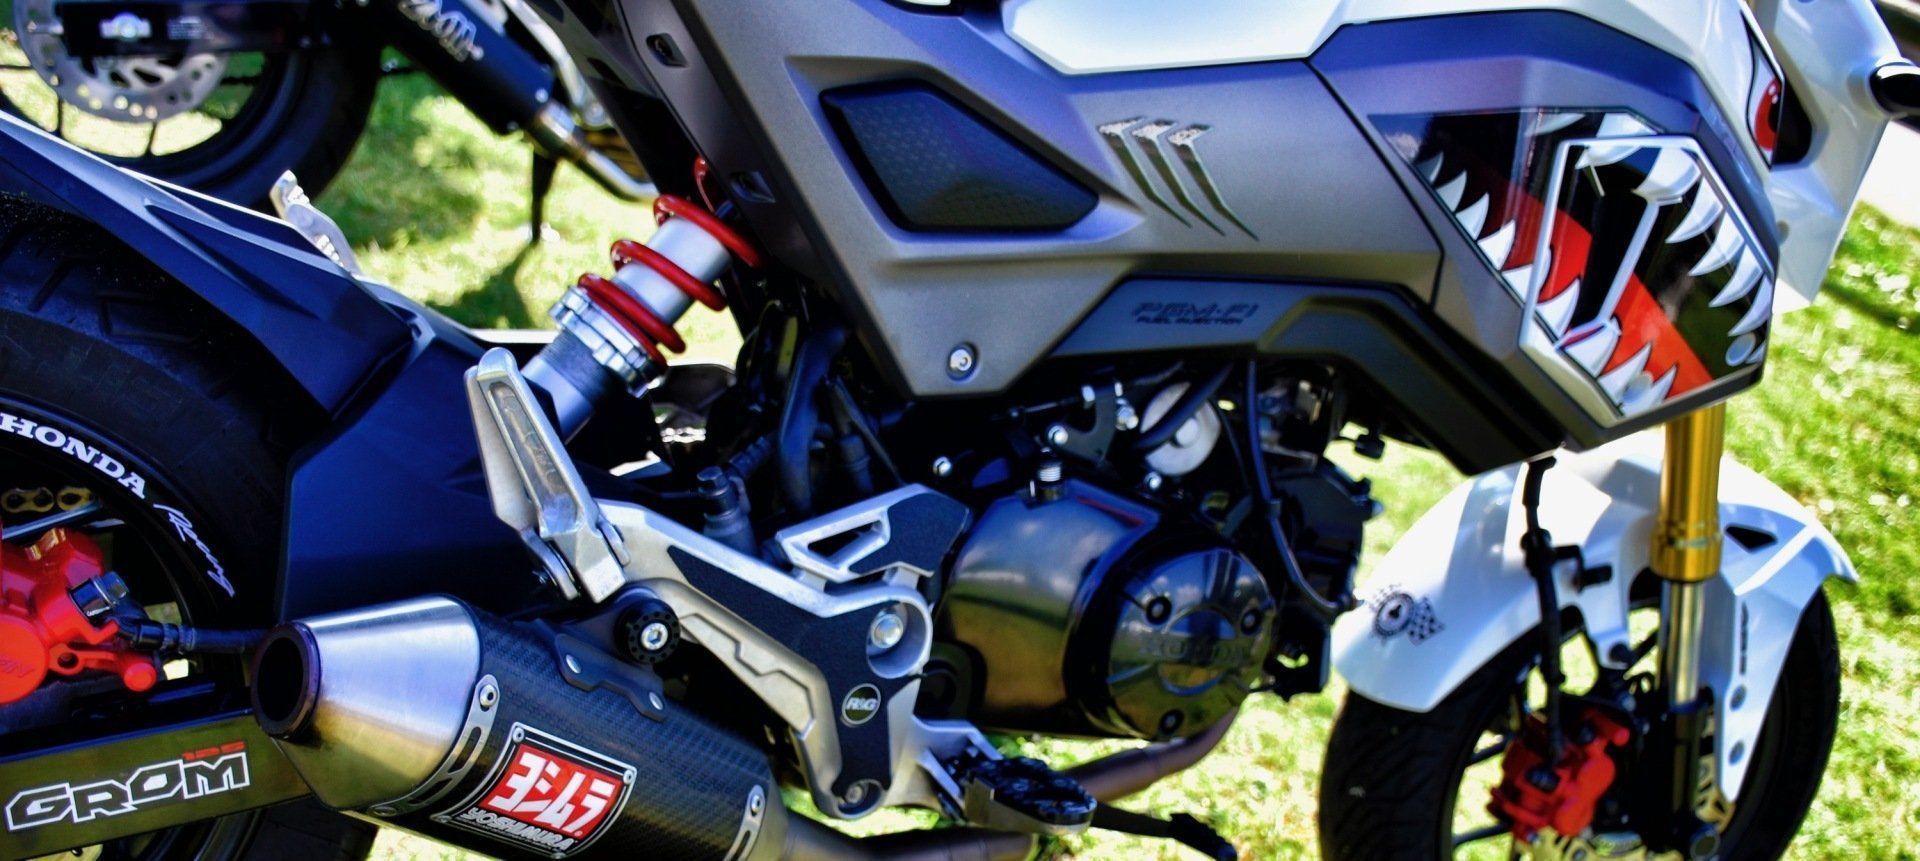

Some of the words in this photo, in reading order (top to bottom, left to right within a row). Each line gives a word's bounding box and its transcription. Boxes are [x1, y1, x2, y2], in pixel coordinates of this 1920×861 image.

[0, 411, 146, 500] HONDA
[5, 752, 251, 832] GROM
[460, 806, 576, 851] YOSHIMURA
[488, 752, 616, 833] ヨシムラ
